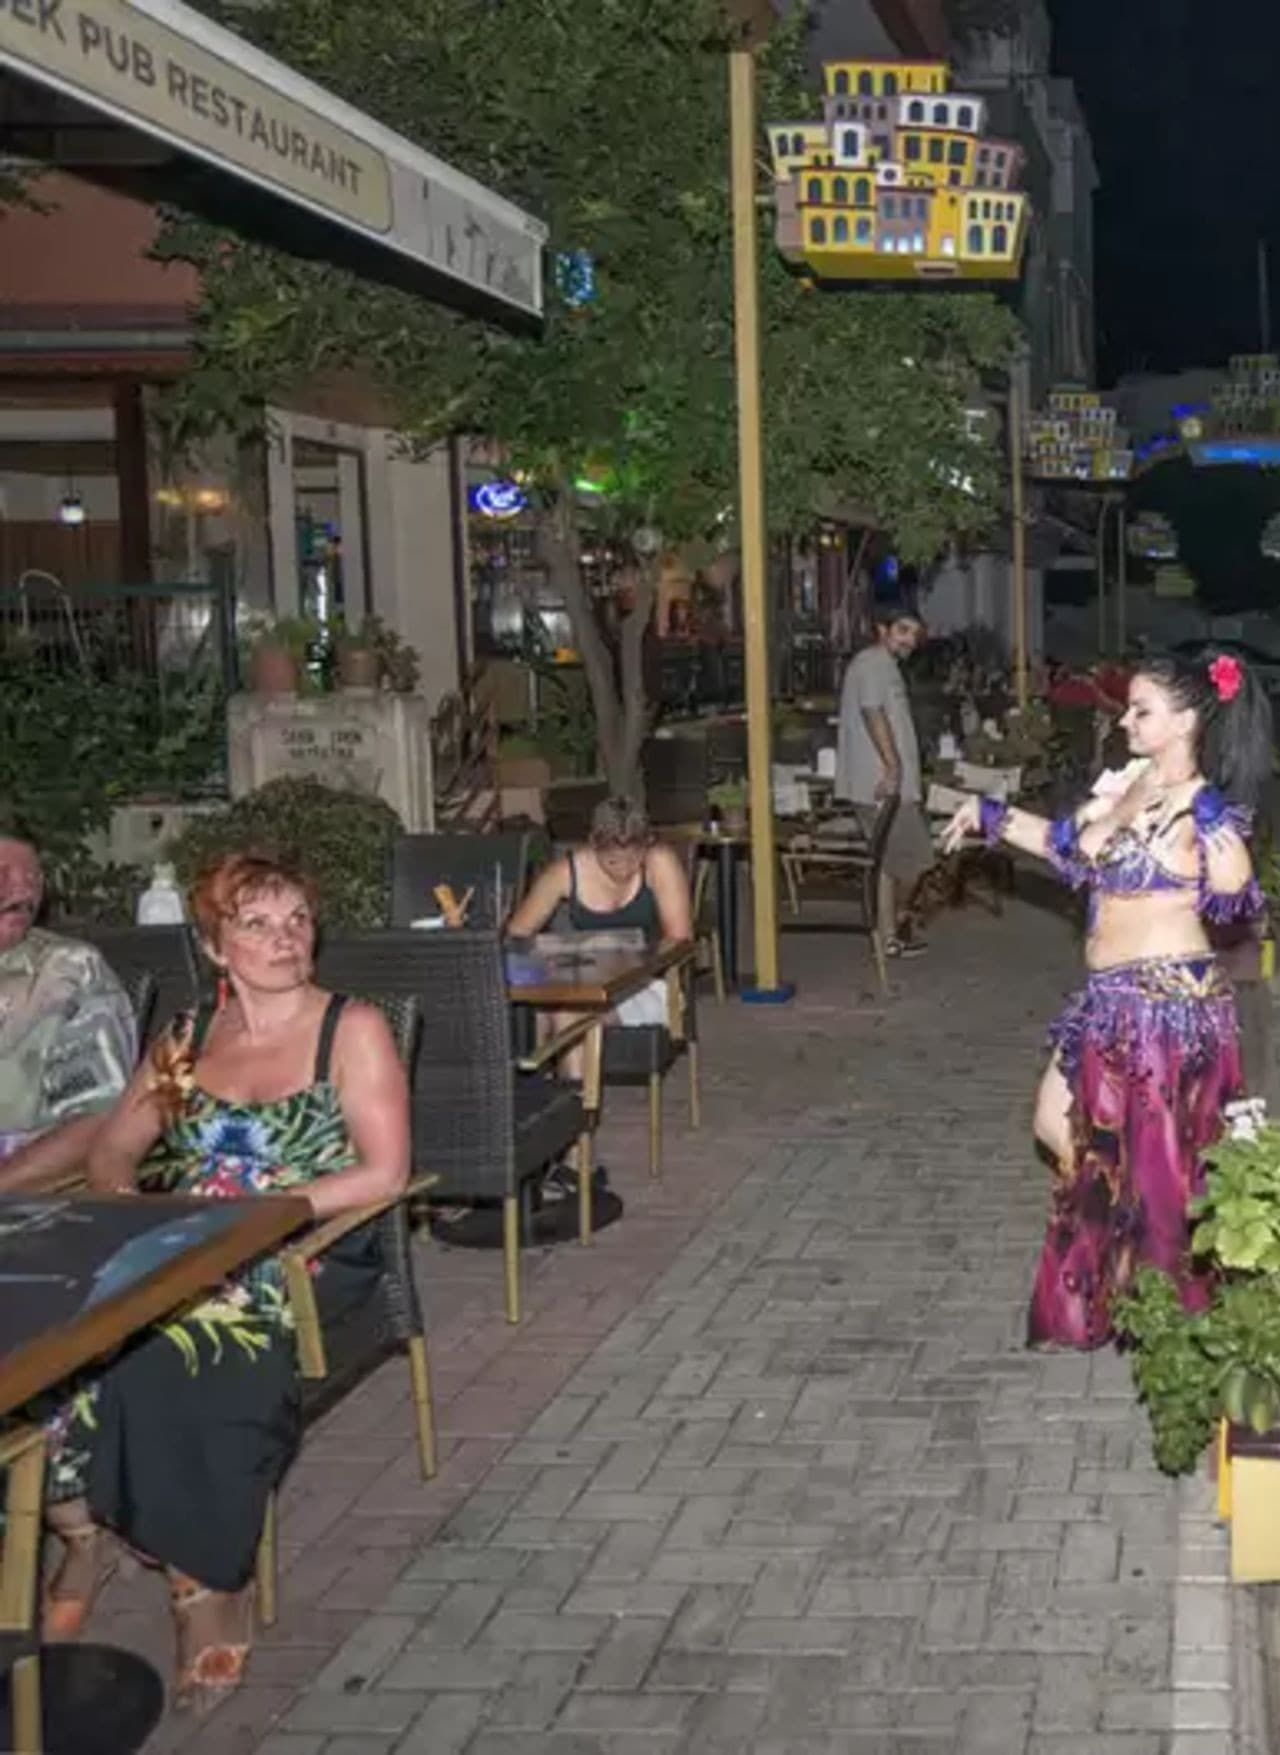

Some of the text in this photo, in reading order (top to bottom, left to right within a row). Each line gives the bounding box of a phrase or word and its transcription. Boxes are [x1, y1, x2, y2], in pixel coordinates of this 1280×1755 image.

[0, 0, 362, 195] EK PUB RESTAURANT
